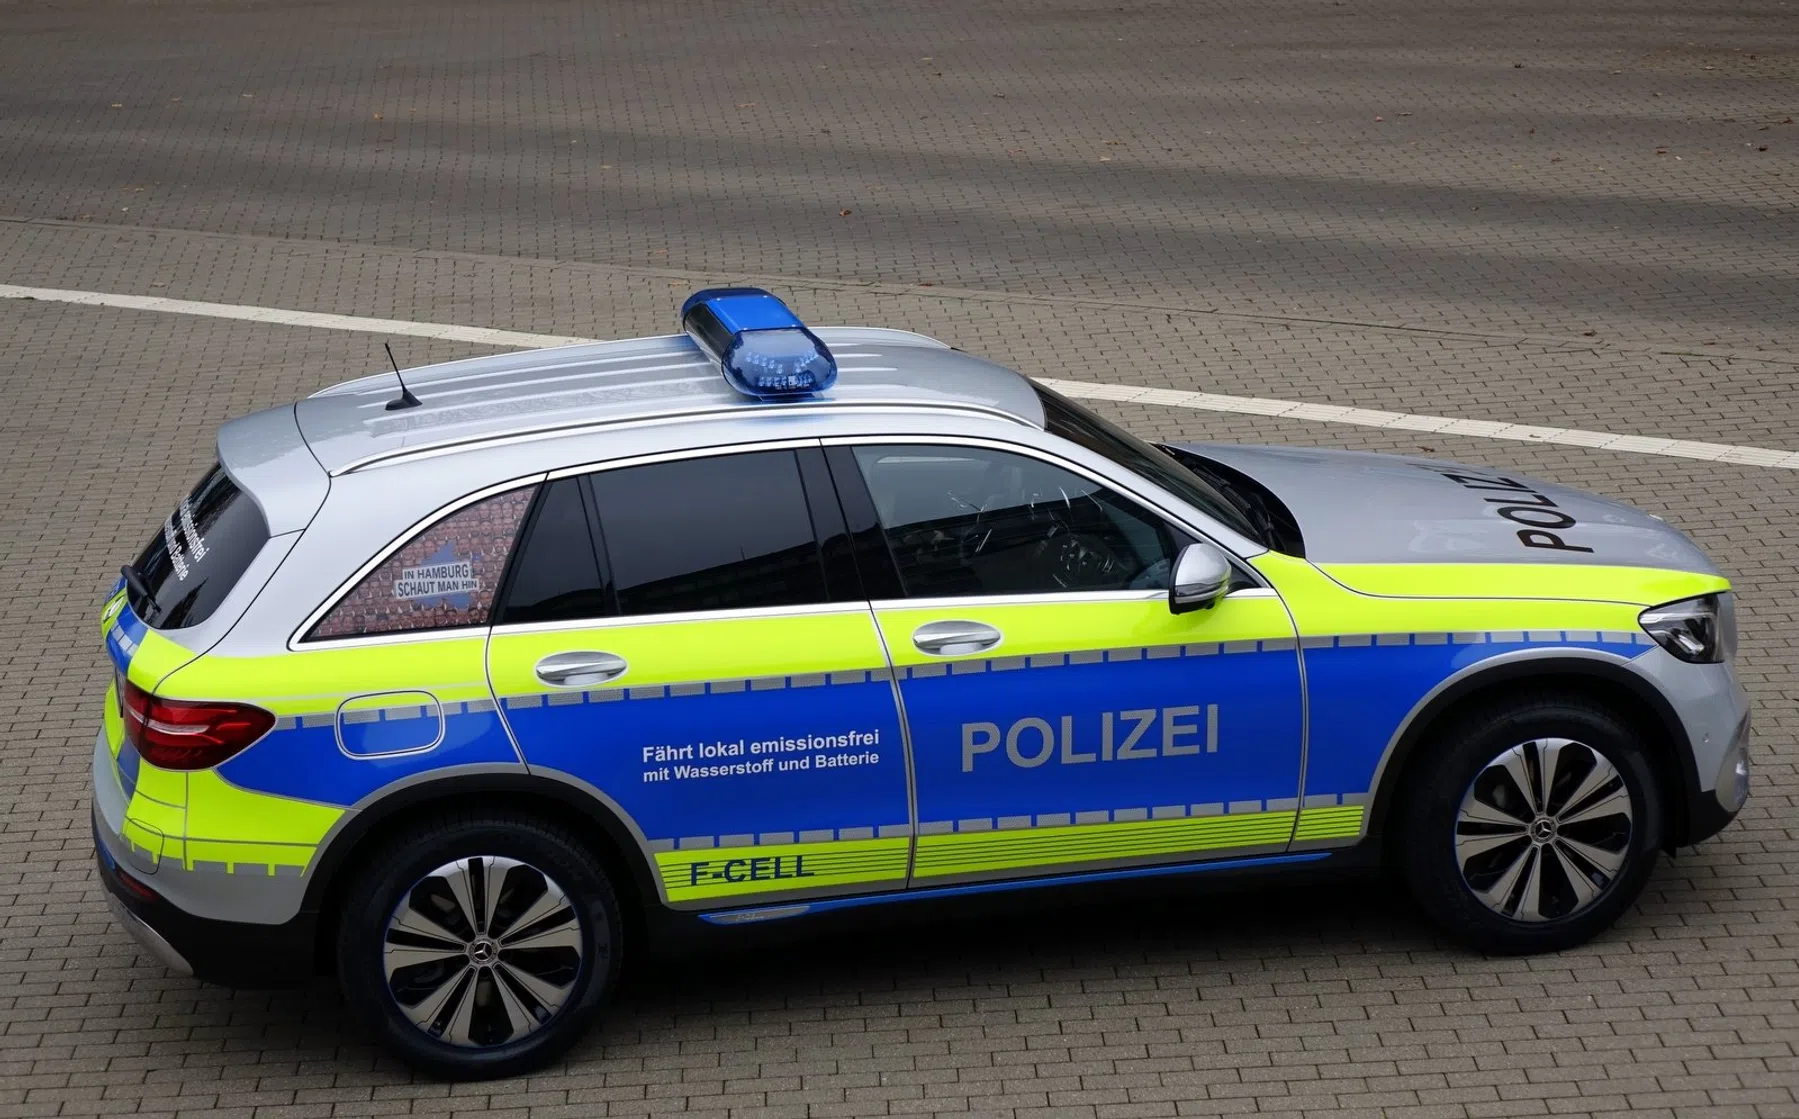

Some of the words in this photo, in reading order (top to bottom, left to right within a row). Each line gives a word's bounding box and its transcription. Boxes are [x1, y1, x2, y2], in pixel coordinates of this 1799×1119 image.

[404, 571, 414, 580] IN
[418, 564, 469, 579] HAMBURG
[398, 581, 435, 597] SCHAUT
[438, 580, 459, 592] MAN
[462, 579, 477, 590] HIN
[643, 744, 694, 763] Fährt
[699, 740, 744, 758] lokal
[750, 729, 880, 755] emissionsfrei
[962, 703, 1219, 773] POLIZEI
[643, 767, 670, 783] mit
[674, 758, 774, 780] Wasserstoff
[778, 755, 810, 772] und
[815, 751, 879, 769] Batterie
[691, 855, 815, 886] F-CELL
